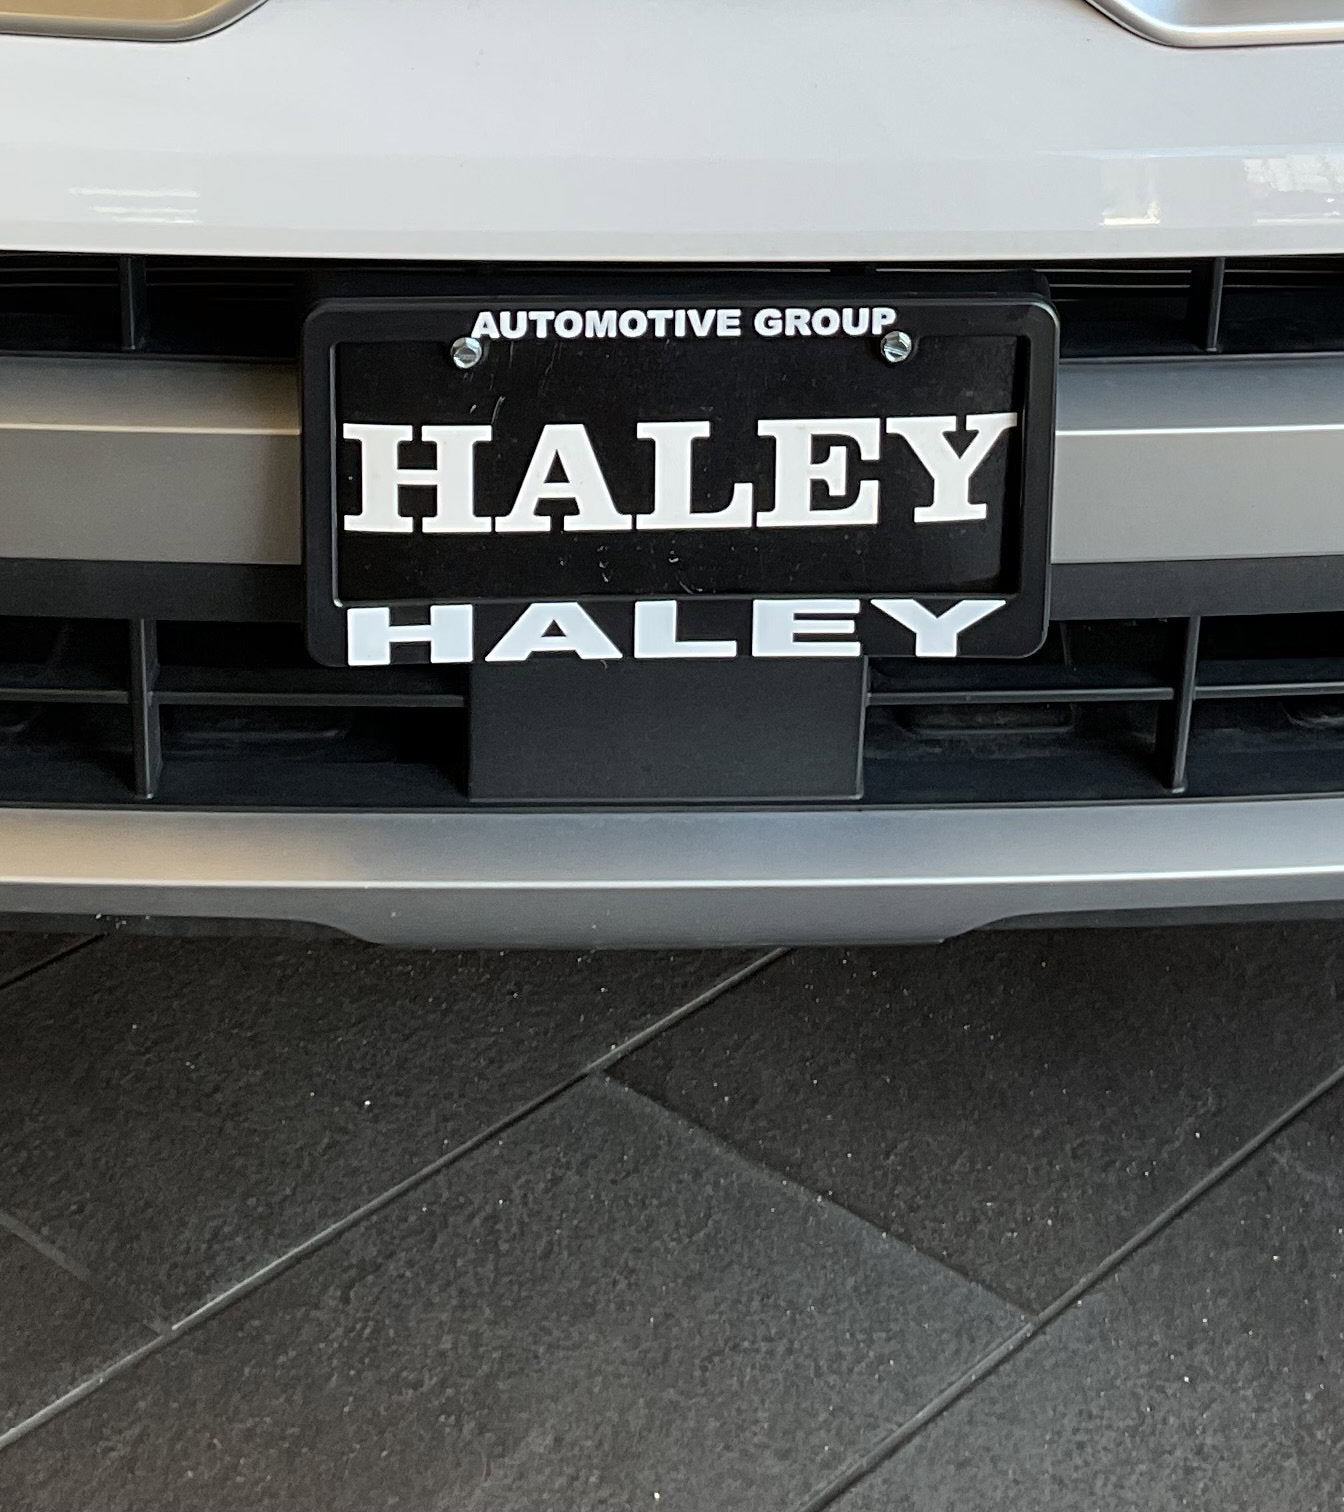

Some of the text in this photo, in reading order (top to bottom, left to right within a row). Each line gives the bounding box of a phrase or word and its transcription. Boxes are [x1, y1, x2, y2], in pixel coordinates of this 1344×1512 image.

[473, 307, 898, 340] AUTOMOTIVE GROUP
[343, 413, 1017, 533] HALEY
[347, 600, 1007, 666] HALEY
